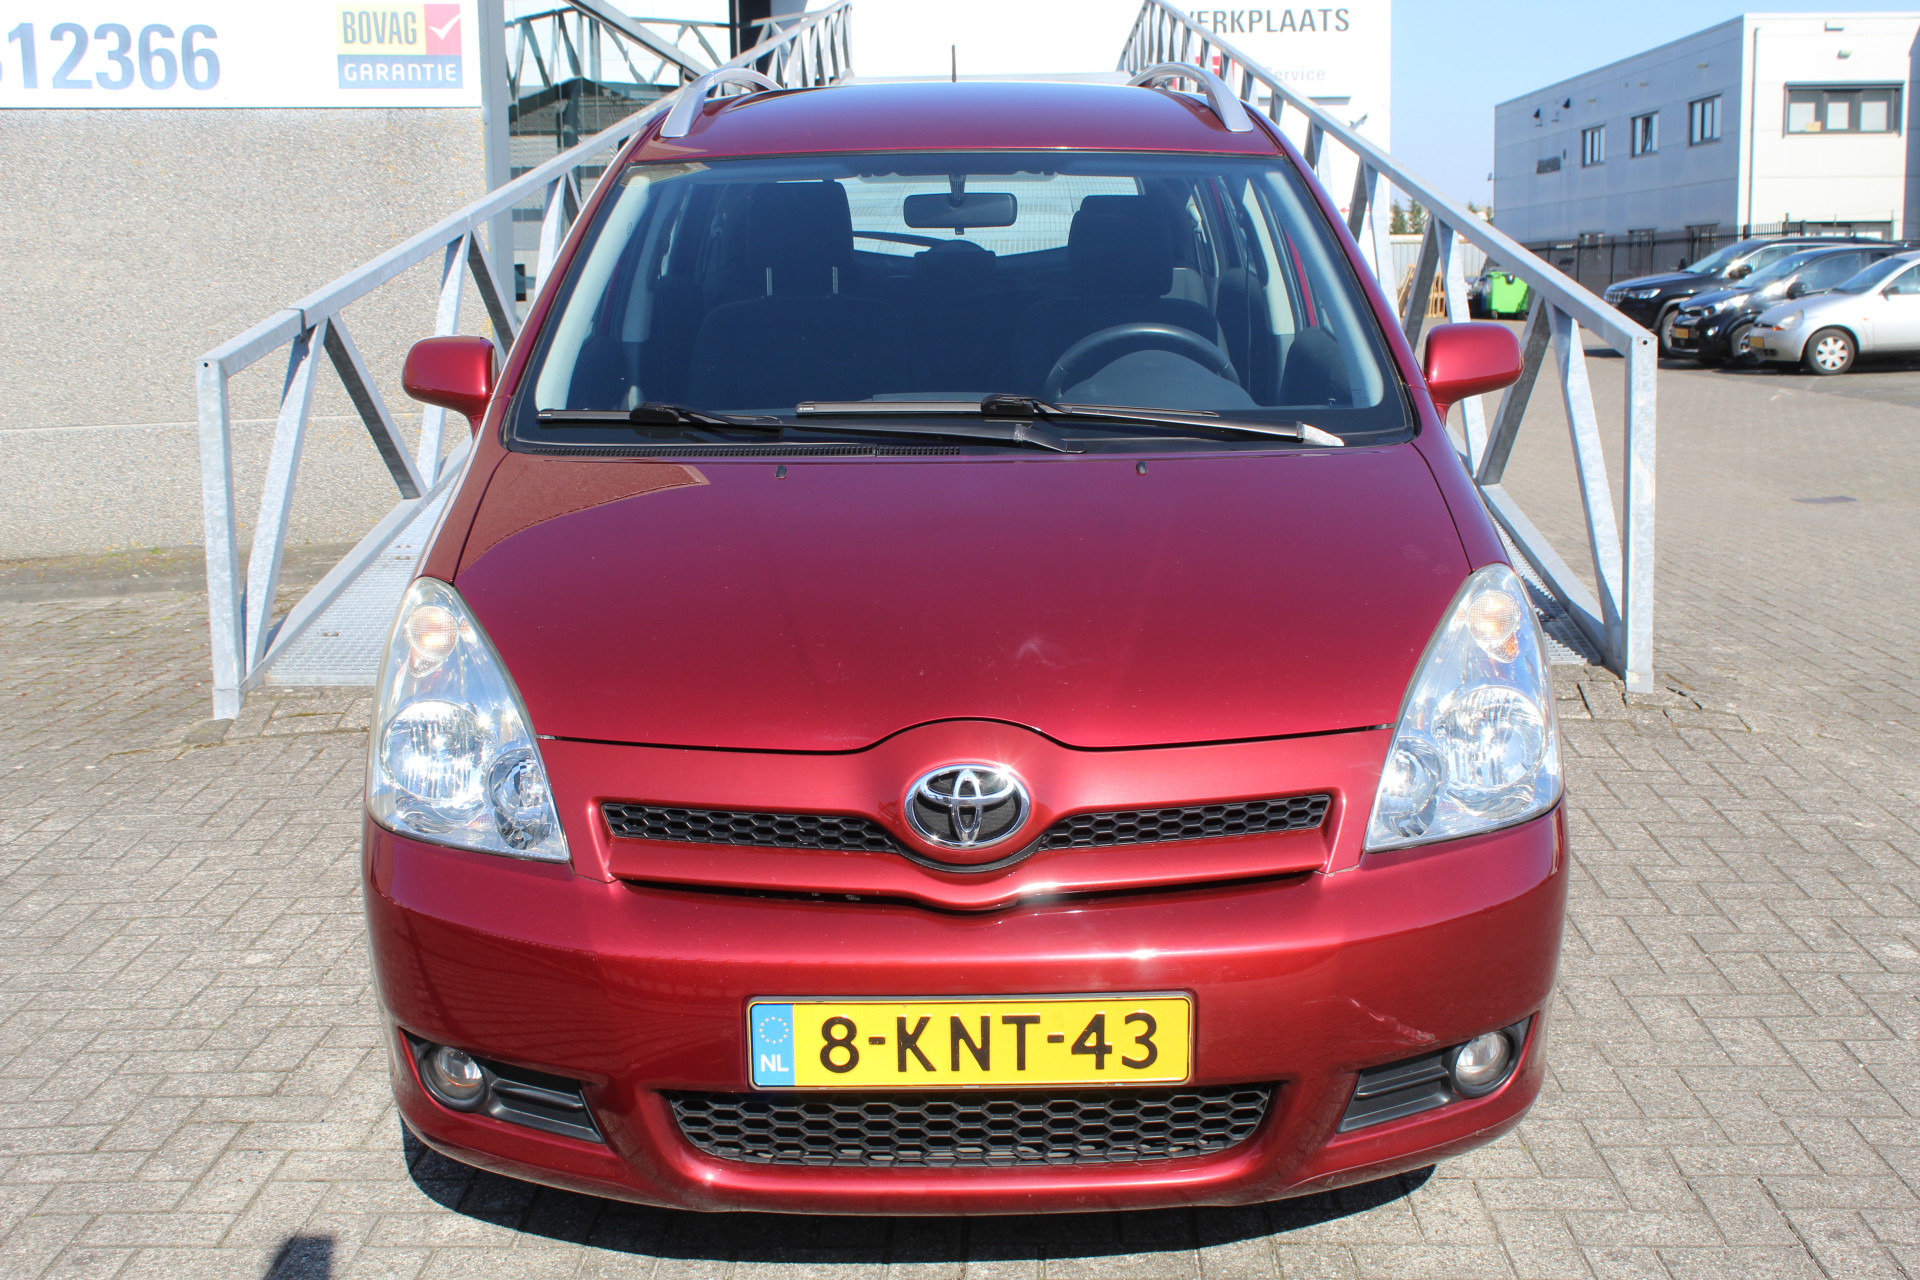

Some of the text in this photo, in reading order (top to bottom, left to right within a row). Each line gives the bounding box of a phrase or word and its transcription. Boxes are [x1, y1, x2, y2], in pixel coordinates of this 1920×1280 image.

[342, 10, 417, 45] BOVAG
[1191, 9, 1350, 33] ERKPLAATS
[0, 22, 220, 90] 12366
[344, 63, 457, 82] GARANTIE
[819, 1011, 1158, 1074] 8-KNT-43
[760, 1054, 789, 1072] NL
